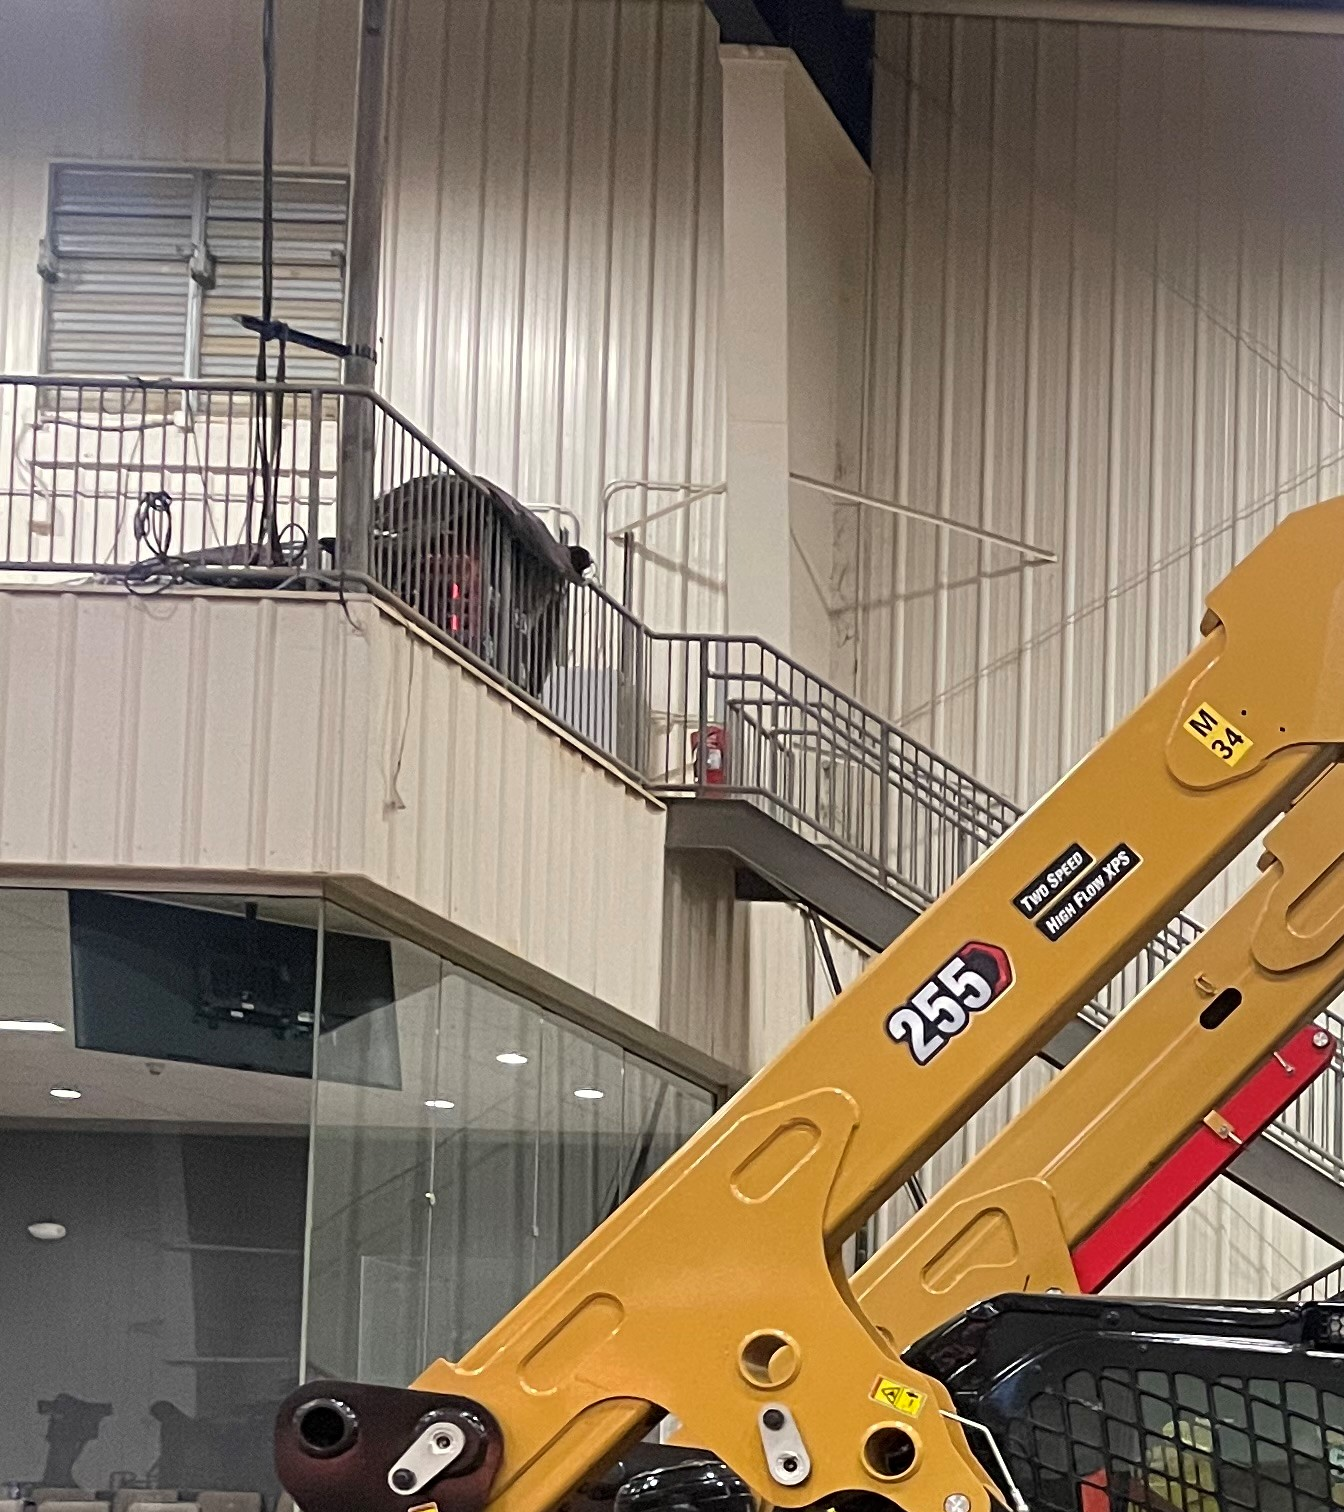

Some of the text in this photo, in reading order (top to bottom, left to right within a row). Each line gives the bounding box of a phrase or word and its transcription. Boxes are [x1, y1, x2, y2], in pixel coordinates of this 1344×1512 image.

[1189, 709, 1218, 737] M
[1211, 728, 1244, 760] 34
[1046, 851, 1083, 889] SPEED
[1073, 874, 1105, 908] FLOW
[1102, 850, 1131, 881] XPS
[888, 956, 993, 1063] 255
